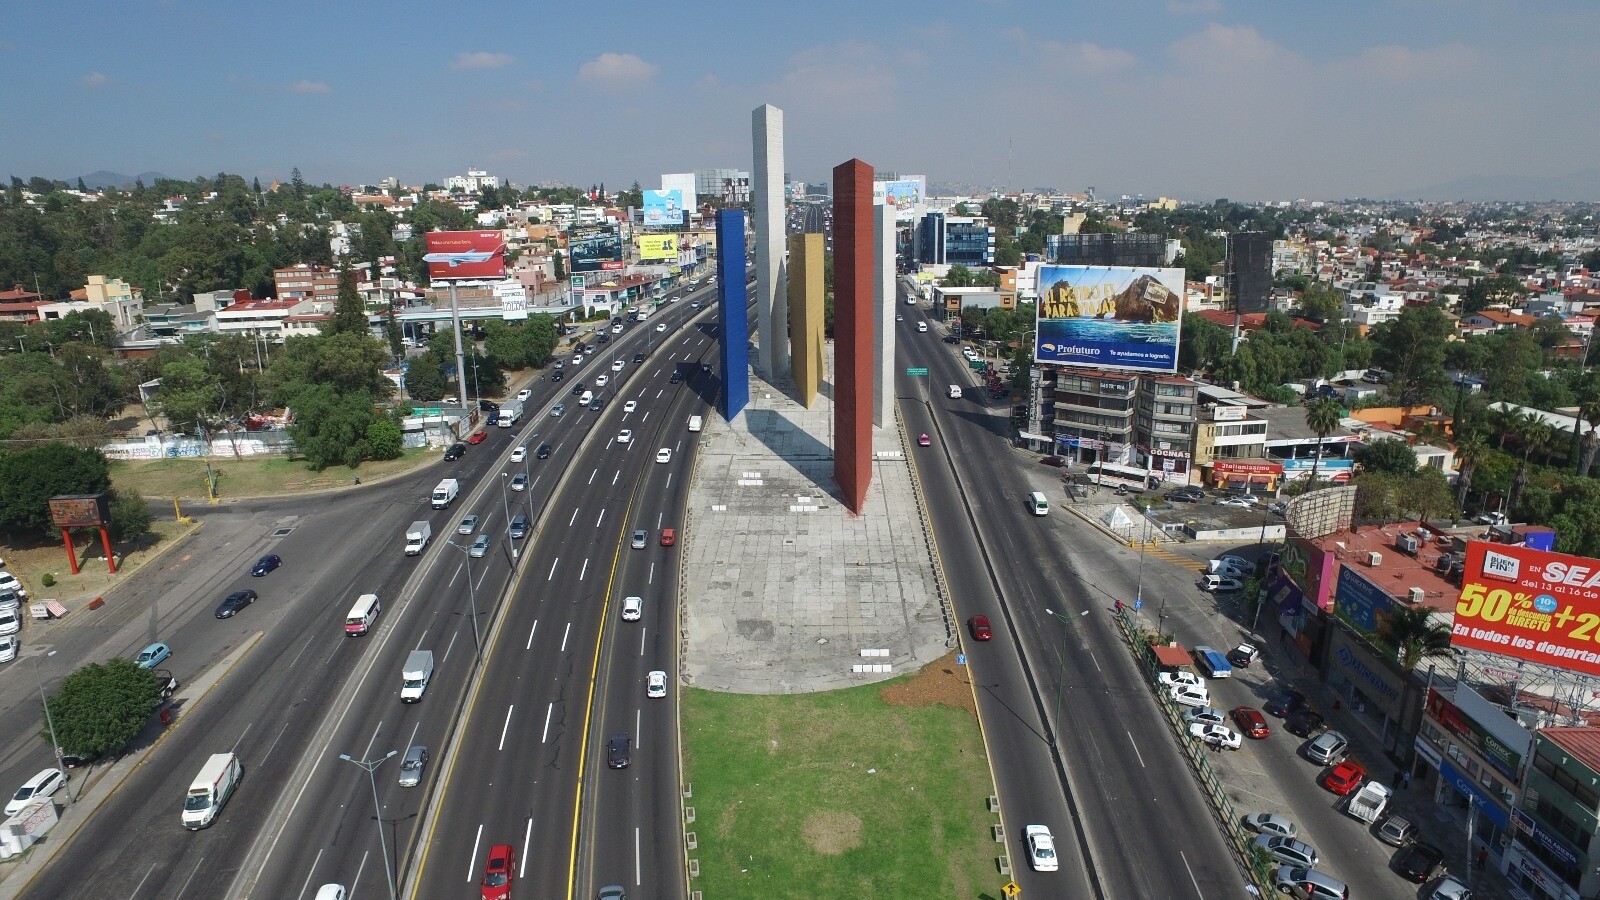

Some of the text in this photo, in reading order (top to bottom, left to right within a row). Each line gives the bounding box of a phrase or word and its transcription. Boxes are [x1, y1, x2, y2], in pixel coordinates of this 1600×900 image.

[1059, 284, 1101, 303] RETIRO
[1044, 300, 1117, 318] PARA VIAJAR
[1057, 344, 1100, 355] Profuturo
[1151, 450, 1191, 459] COCINAS
[1491, 557, 1515, 567] BUEN
[1522, 580, 1538, 588] del
[1542, 583, 1552, 591] 13
[1570, 588, 1581, 596] 16
[1584, 591, 1598, 599] de
[1506, 615, 1551, 632] DIRECTO
[1508, 607, 1552, 621] de descuento
[1453, 624, 1468, 636] En
[1471, 627, 1510, 645] todos
[1511, 635, 1534, 650] los
[1486, 736, 1512, 758] Comex
[1456, 779, 1488, 807] Comex
[1535, 828, 1552, 845] PREPA
[1553, 842, 1577, 863] ABIERTA
[1521, 858, 1546, 885] FedEx
